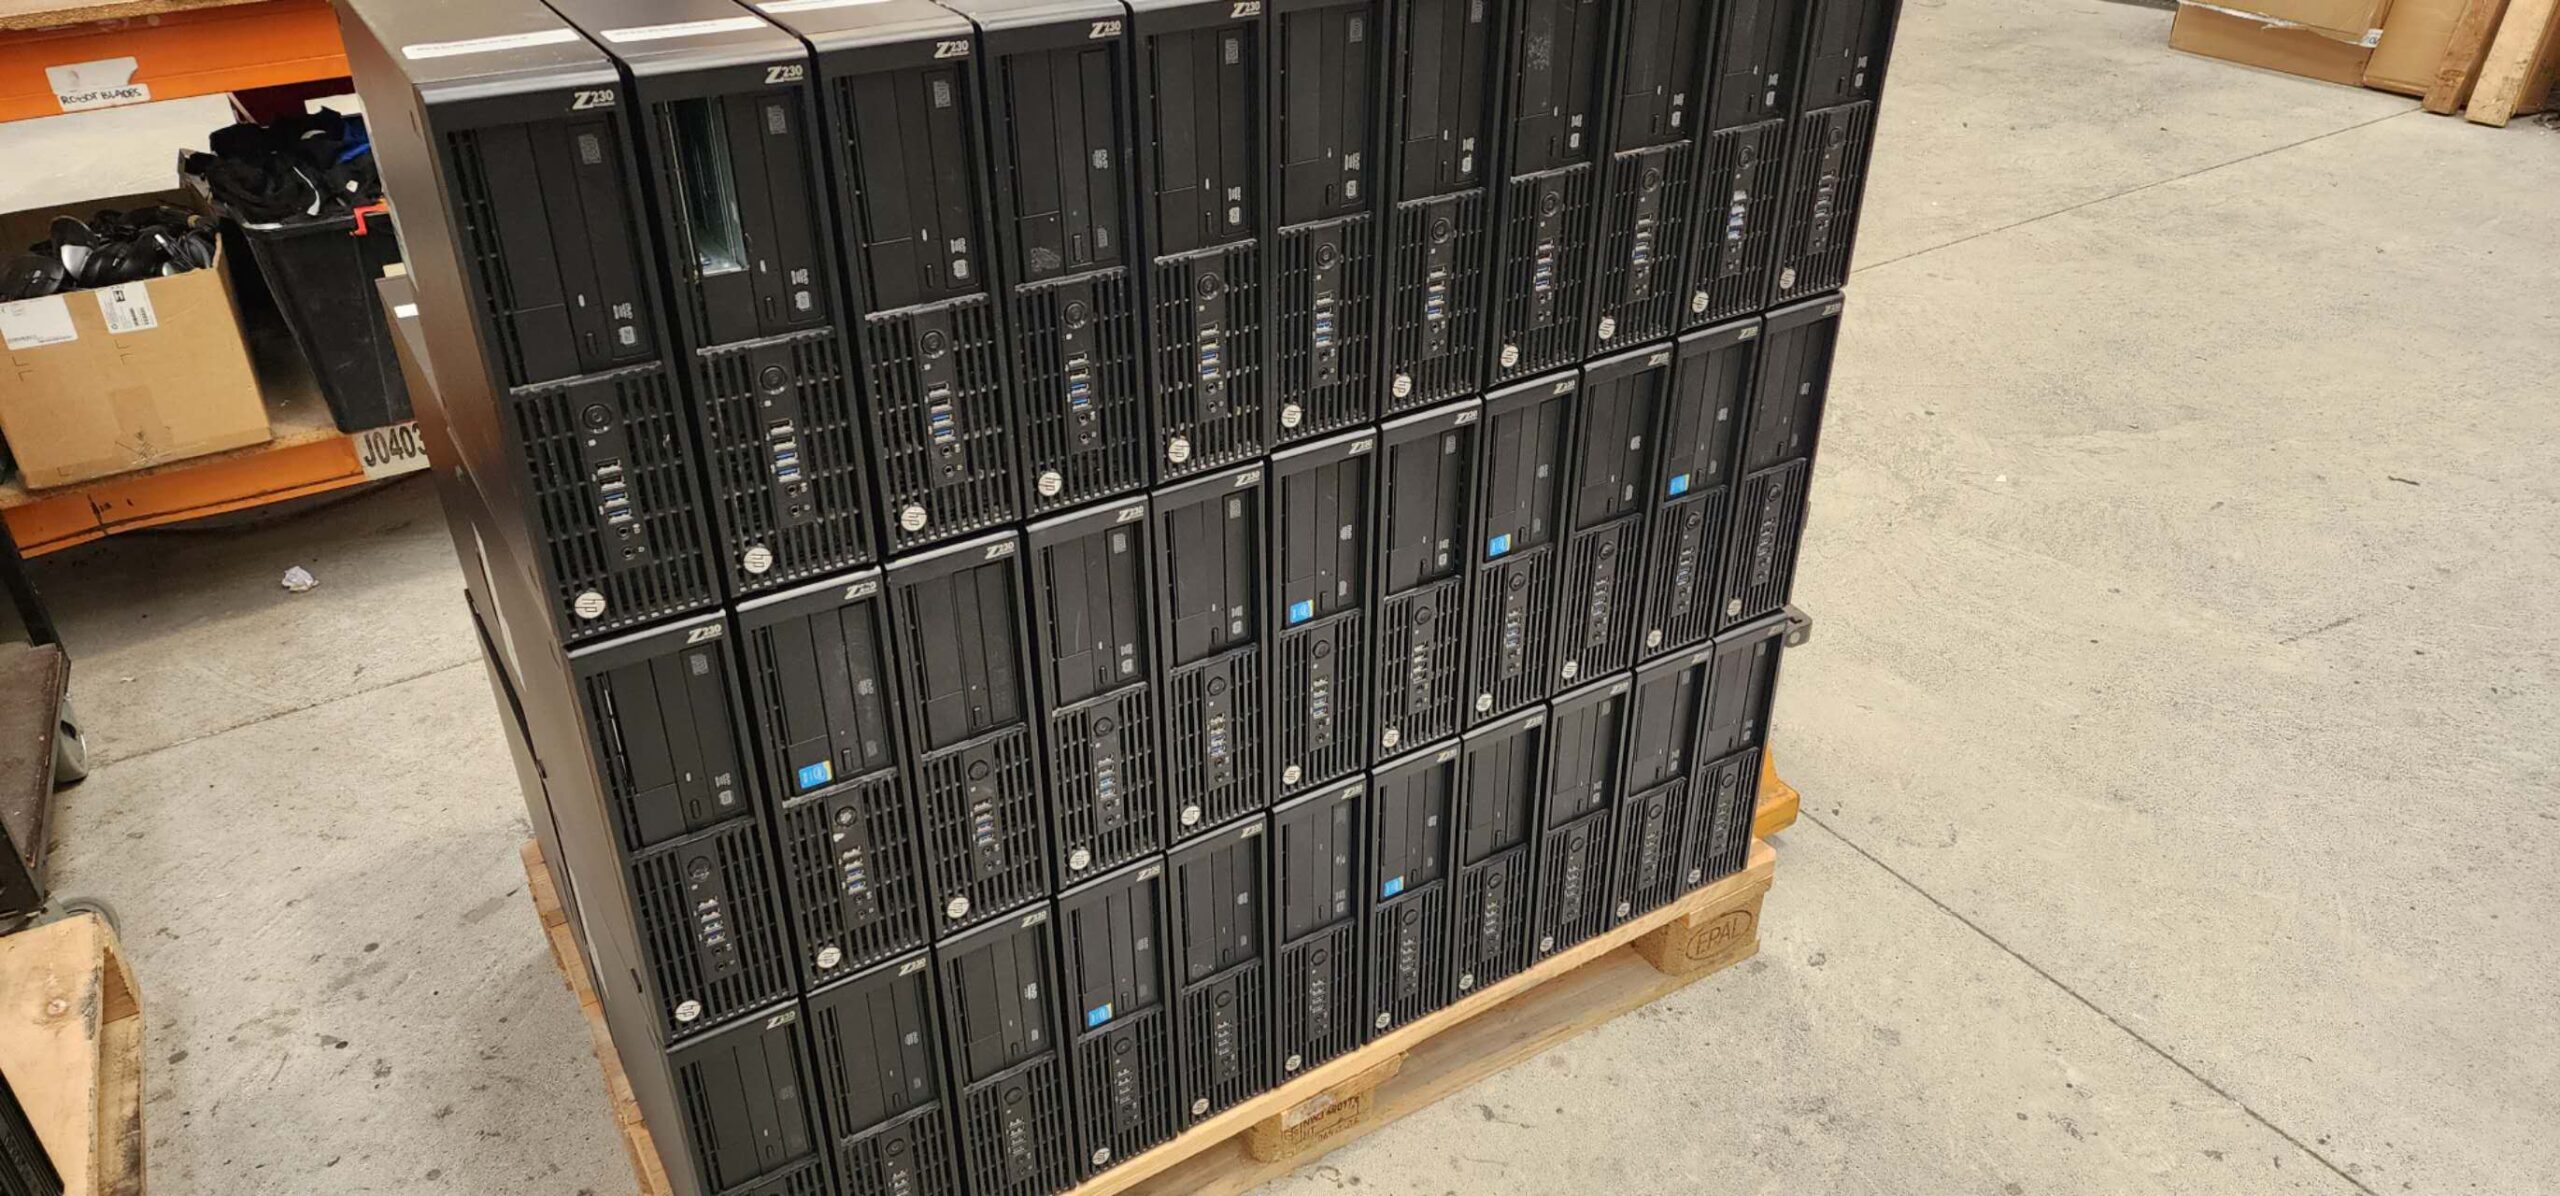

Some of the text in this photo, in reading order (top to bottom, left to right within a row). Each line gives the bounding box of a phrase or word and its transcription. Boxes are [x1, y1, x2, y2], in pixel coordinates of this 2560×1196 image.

[1230, 1, 1260, 18] Z230
[1089, 20, 1121, 39] Z230
[934, 40, 969, 59] Z230
[765, 65, 804, 84] Z230
[572, 90, 614, 110] Z230
[984, 541, 1014, 560] Z230
[687, 624, 722, 643] Z230
[1695, 917, 1742, 955] EPAL
